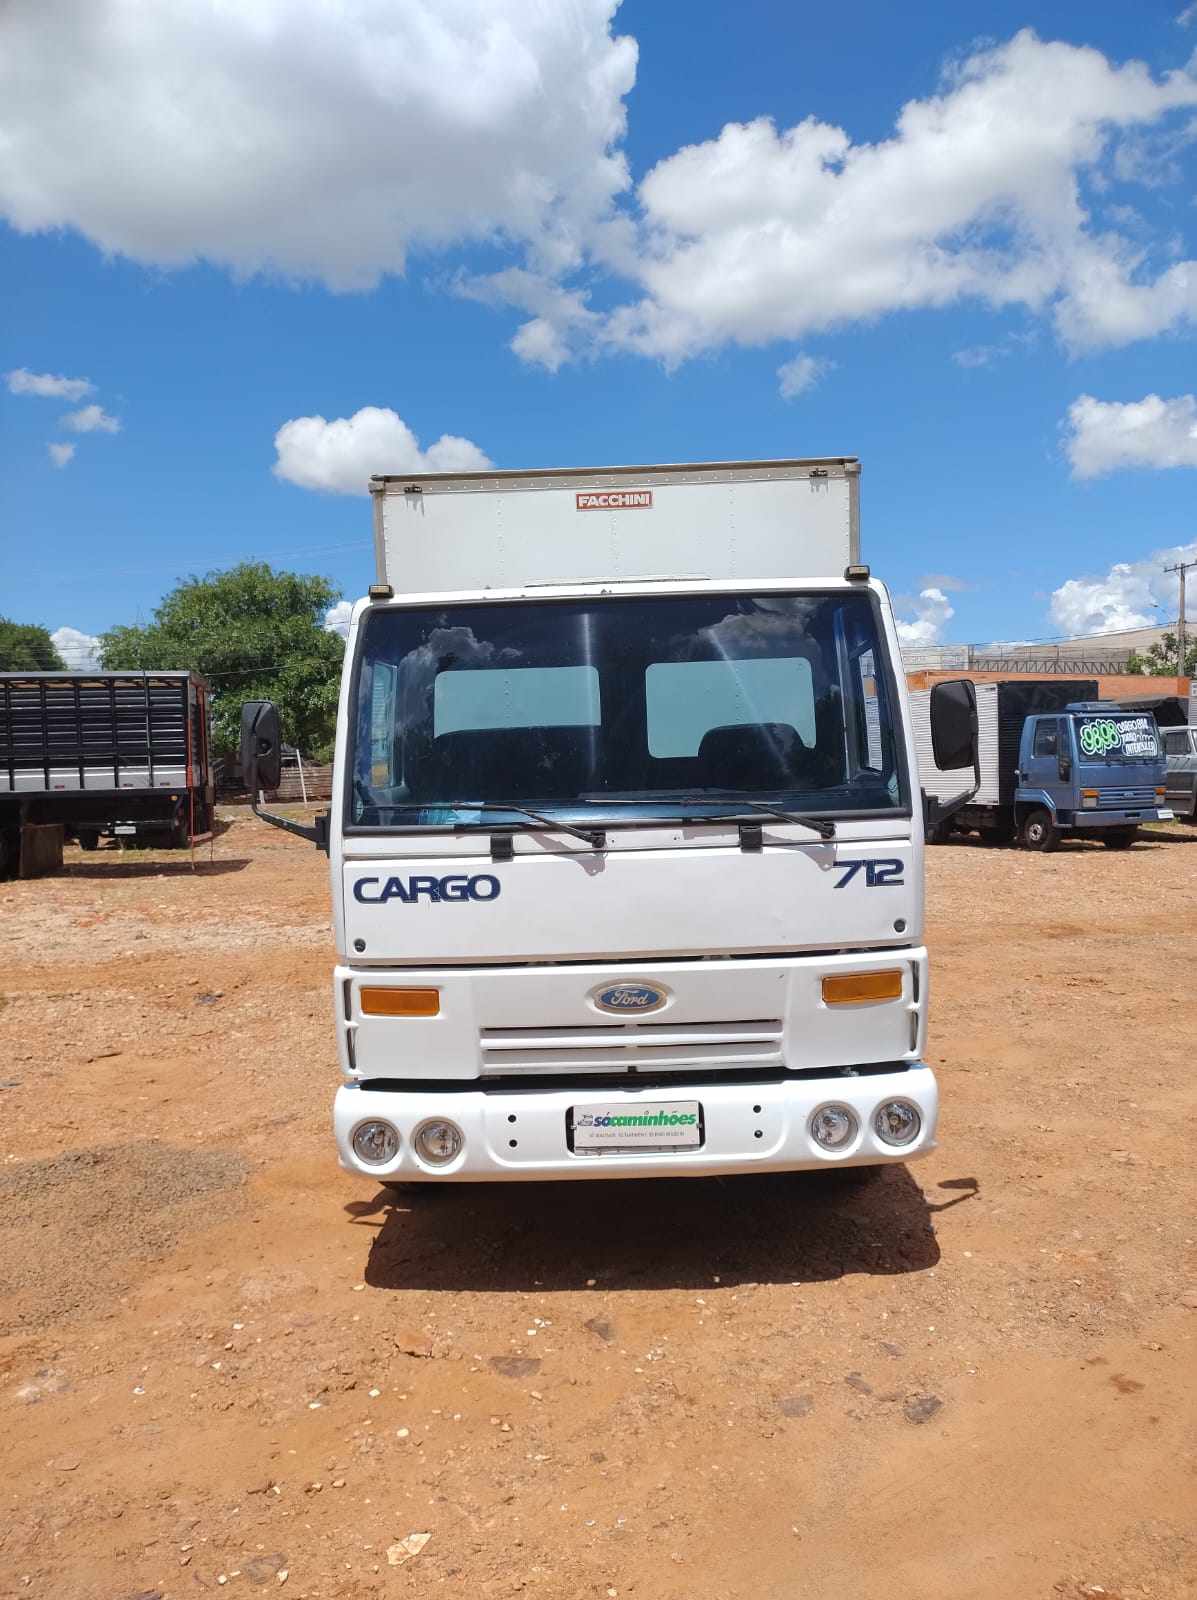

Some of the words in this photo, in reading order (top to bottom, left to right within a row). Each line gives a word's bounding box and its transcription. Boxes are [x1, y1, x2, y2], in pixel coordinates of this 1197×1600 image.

[578, 493, 651, 508] FACCHINI
[832, 858, 905, 889] 712
[353, 874, 501, 904] CARGO
[610, 988, 650, 1005] Ford
